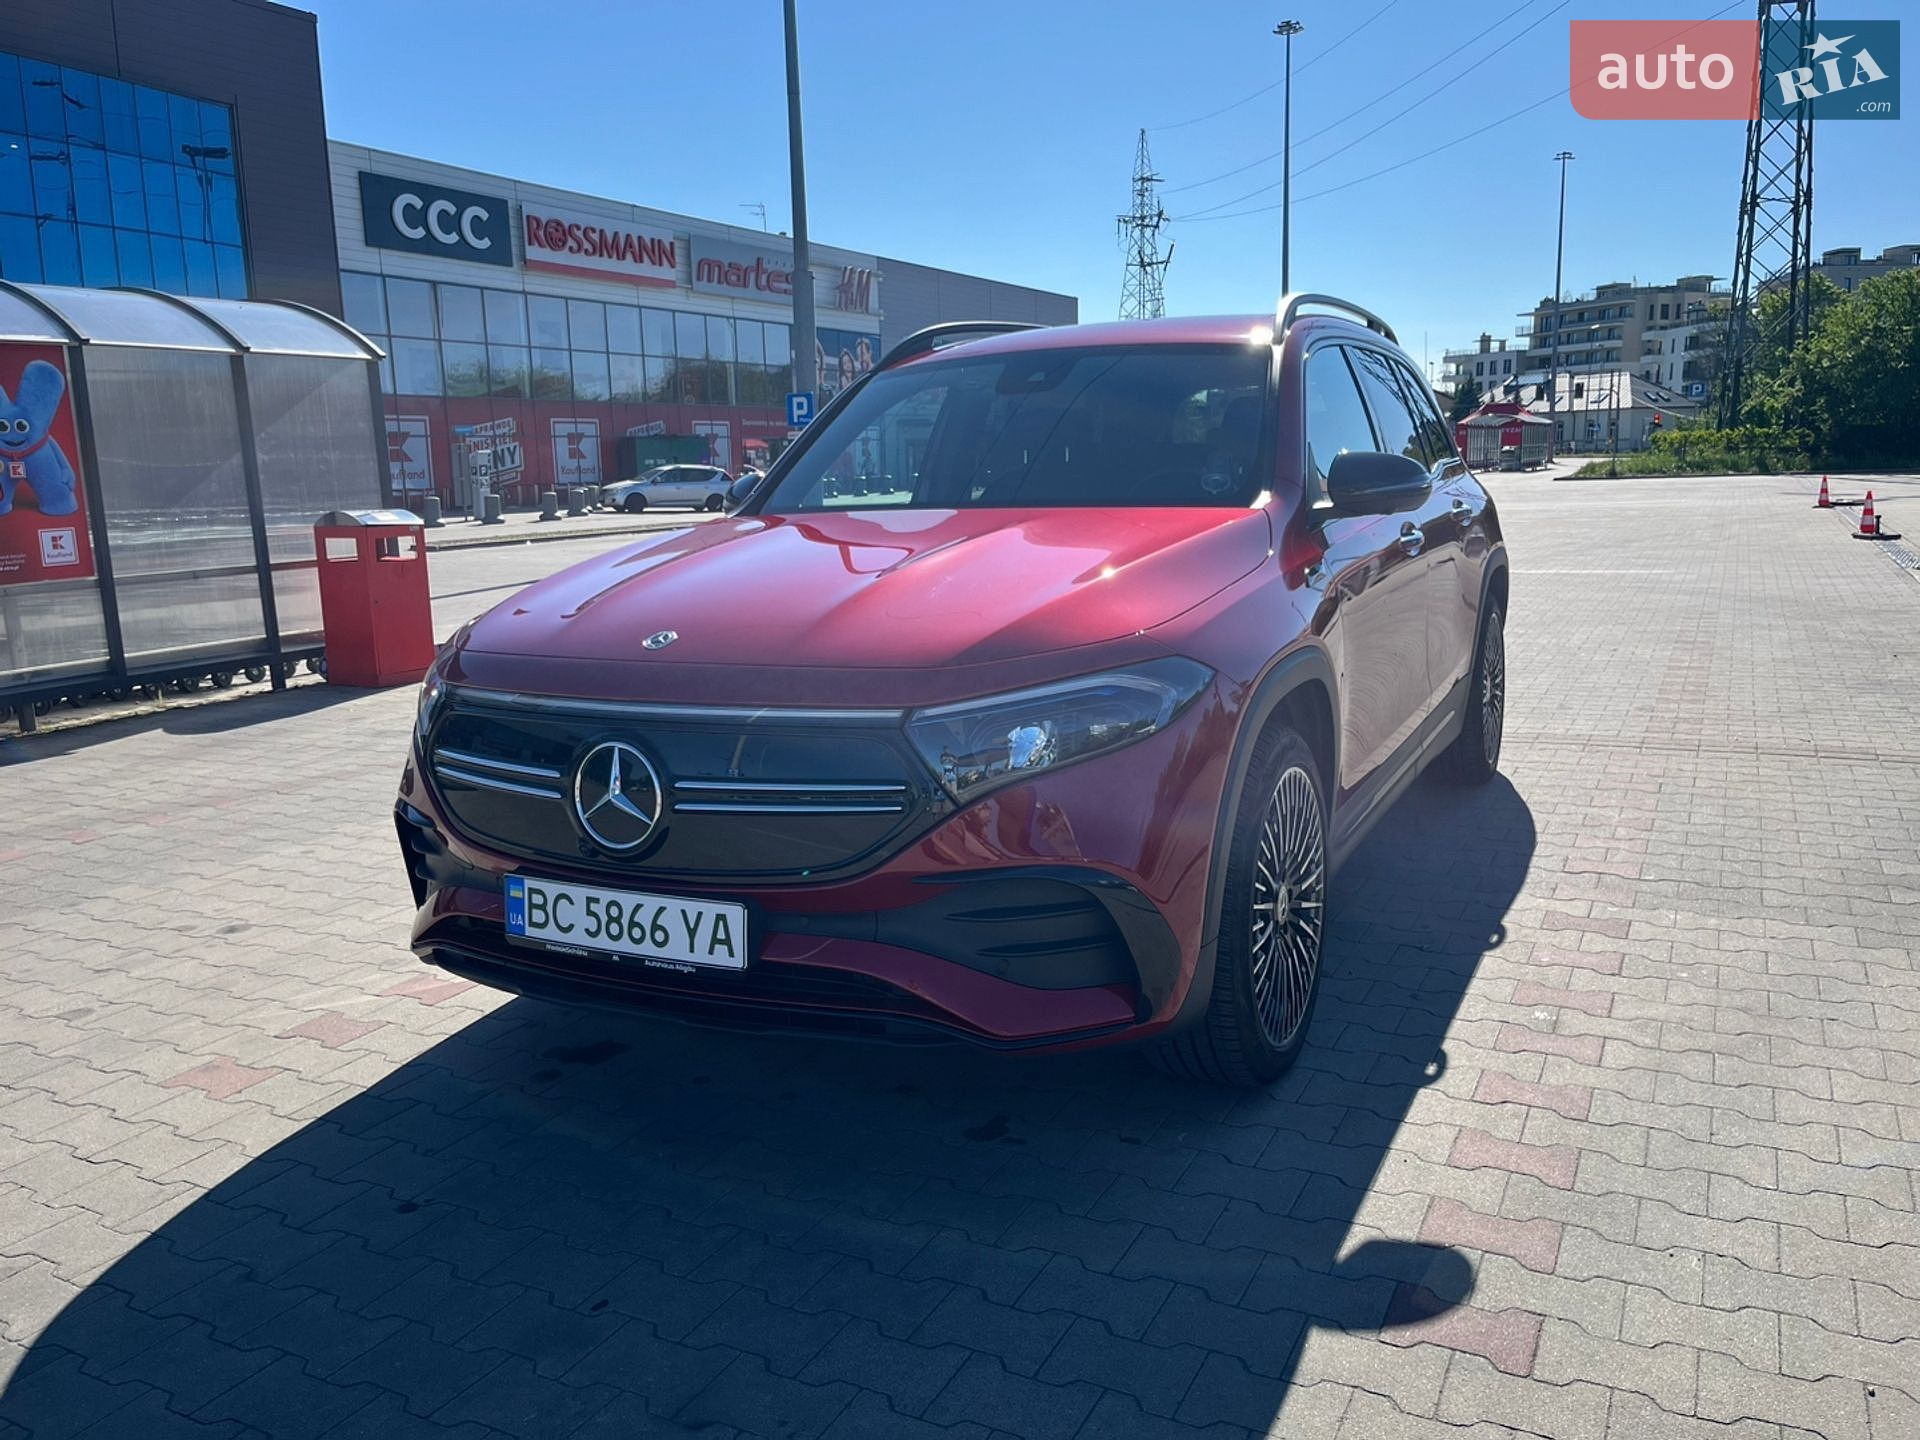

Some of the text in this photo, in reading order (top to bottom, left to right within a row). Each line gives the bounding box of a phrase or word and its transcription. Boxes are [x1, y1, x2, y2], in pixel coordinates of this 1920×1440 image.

[391, 192, 493, 250] CCC
[526, 213, 677, 270] ROSSMANN
[792, 396, 808, 424] P
[509, 912, 524, 926] UA
[526, 886, 736, 959] BC 5866 YA
